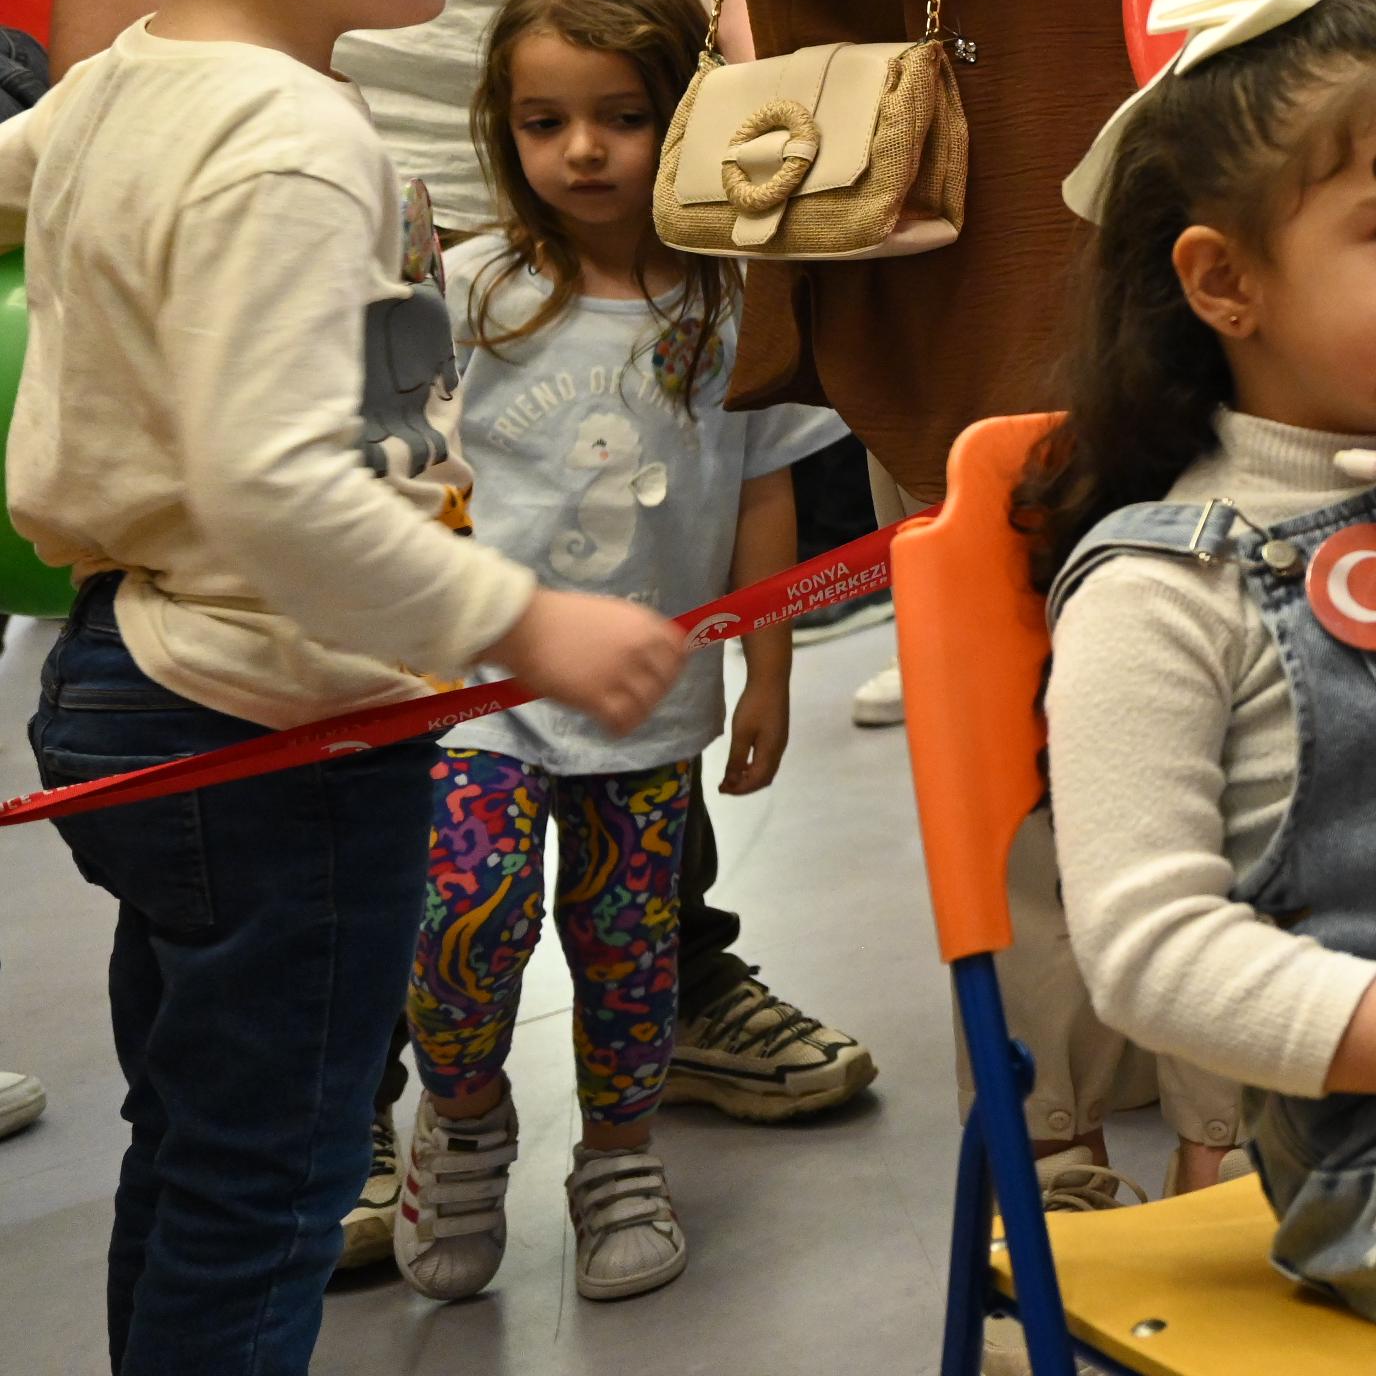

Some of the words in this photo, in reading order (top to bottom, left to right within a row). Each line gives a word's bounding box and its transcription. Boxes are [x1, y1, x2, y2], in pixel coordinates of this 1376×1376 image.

[491, 370, 578, 442] RIEND
[786, 561, 850, 600] KONYA
[427, 699, 502, 731] KONYA
